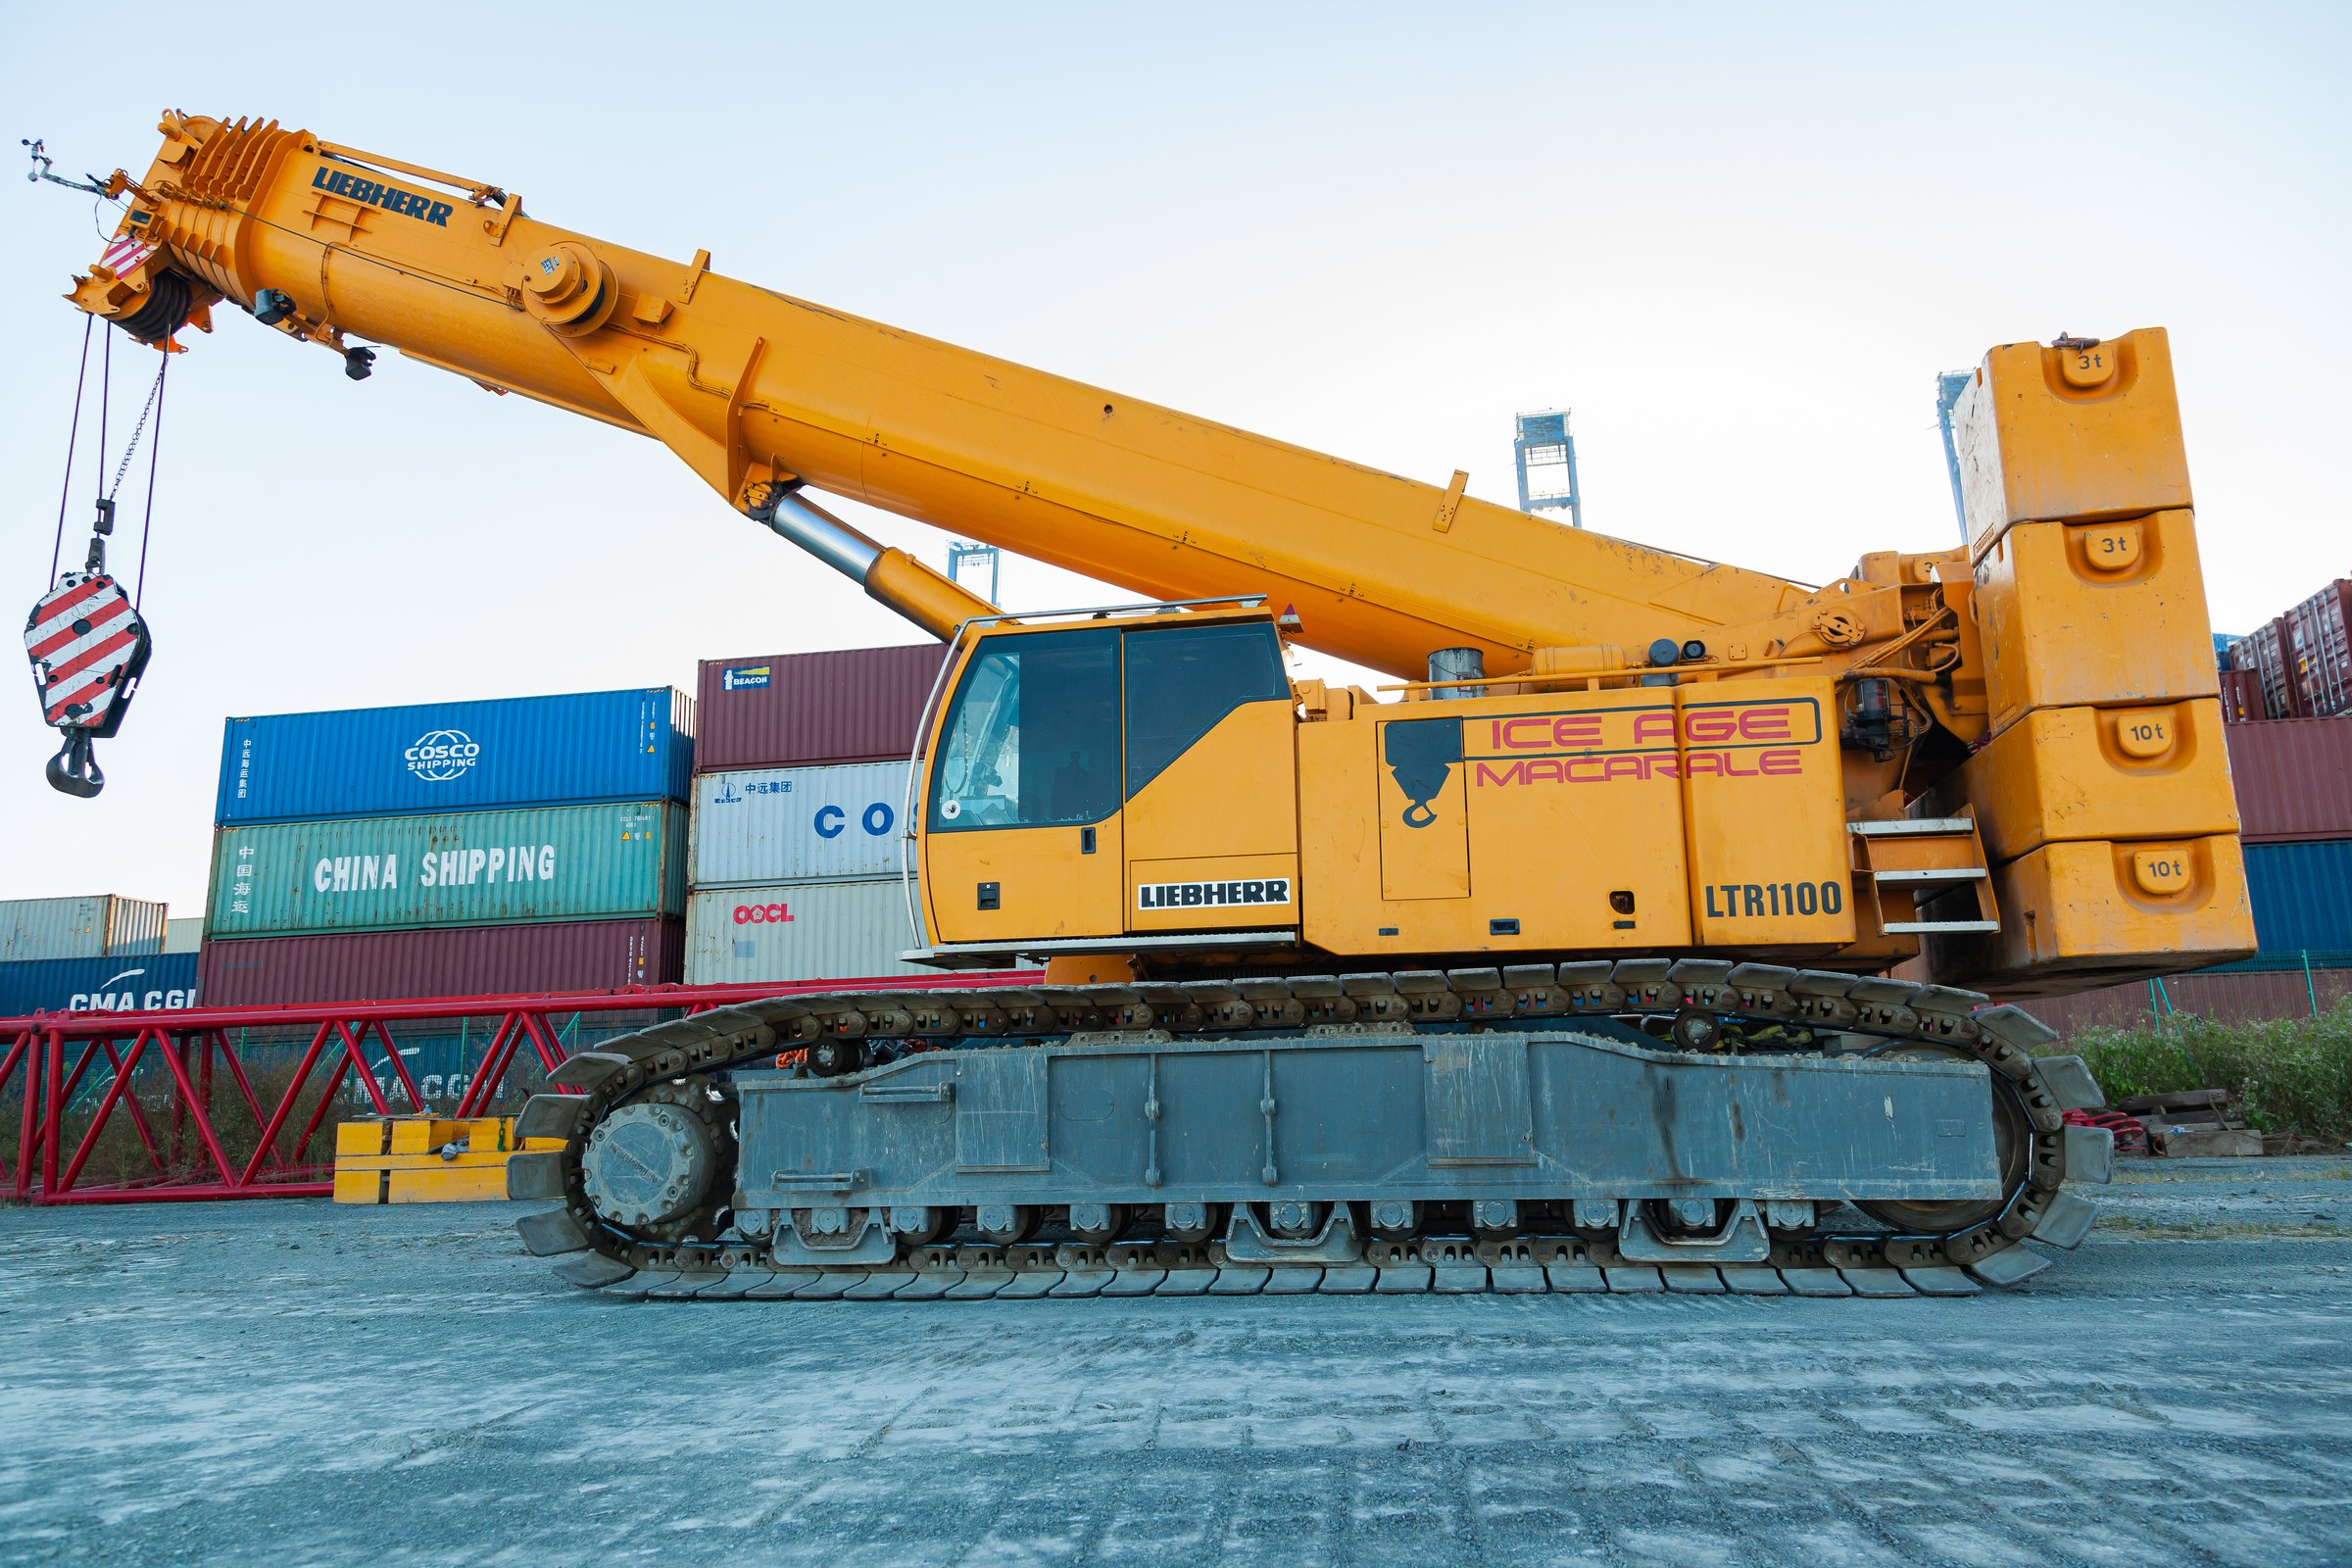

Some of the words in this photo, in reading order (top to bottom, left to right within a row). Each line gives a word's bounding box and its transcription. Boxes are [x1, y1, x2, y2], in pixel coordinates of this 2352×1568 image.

[311, 166, 455, 228] LIEBHERR
[2078, 353, 2102, 369] 3t
[2101, 536, 2127, 554] 3t
[733, 675, 767, 686] BEACON
[1492, 715, 1604, 750] ICE
[1633, 708, 1792, 744] AGE
[2131, 722, 2164, 742] 10t
[404, 742, 480, 761] COSCO
[407, 758, 476, 771] SHIPPING
[1476, 748, 1803, 788] MACARALE
[745, 780, 793, 795] 中远集团
[813, 802, 918, 839] CO
[314, 854, 398, 893] CHINA
[419, 845, 556, 887] SHIPPING
[2148, 859, 2181, 877] 10t
[230, 845, 255, 914] 中国海运
[1141, 880, 1289, 908] LIEBHERR
[1705, 881, 1842, 918] LTR1100
[732, 903, 795, 925] OOCL
[70, 992, 134, 1011] CMA
